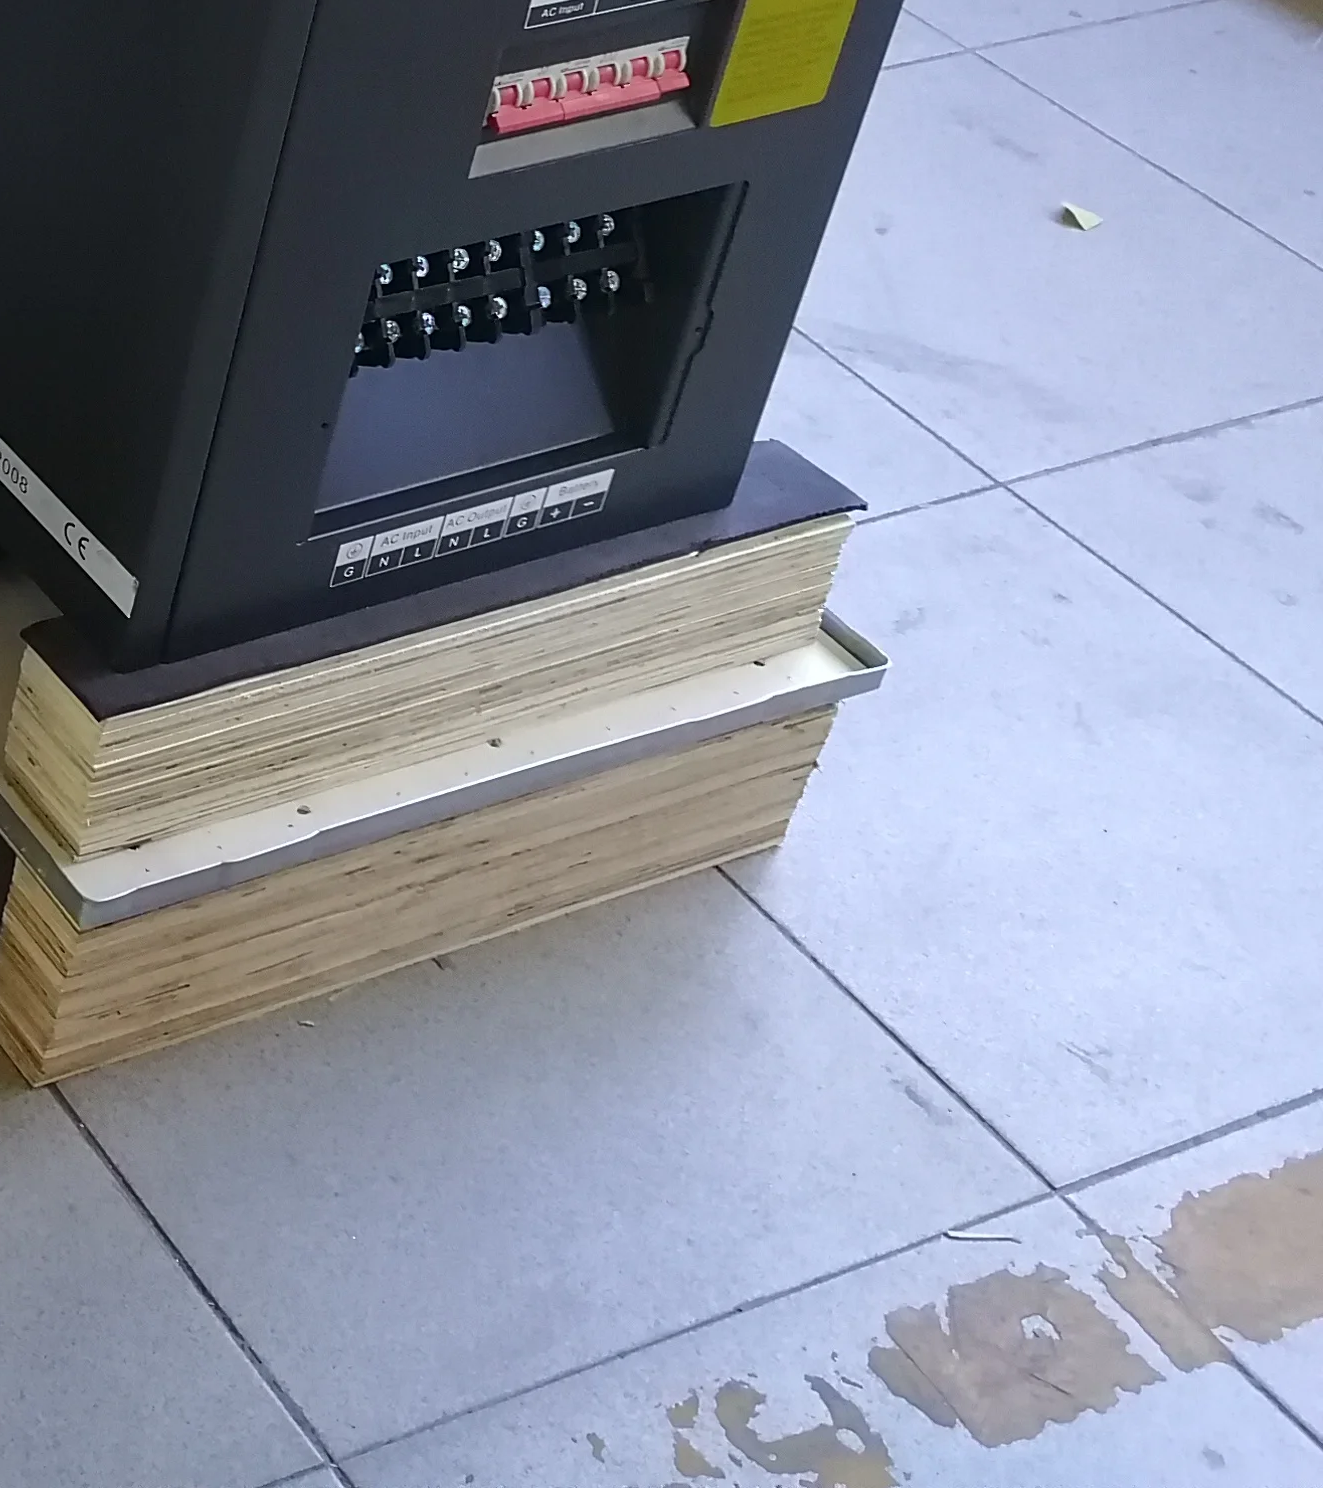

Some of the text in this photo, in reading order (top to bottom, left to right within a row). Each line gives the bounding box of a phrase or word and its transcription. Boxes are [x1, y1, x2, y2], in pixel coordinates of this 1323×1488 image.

[541, 2, 584, 18] AC Input
[445, 514, 466, 529] AC
[380, 524, 433, 548] AC Input
[343, 566, 354, 577] G
[379, 556, 390, 567] N
[414, 547, 423, 558] L
[448, 537, 460, 548] N
[483, 528, 491, 538] L
[516, 517, 528, 528] G
